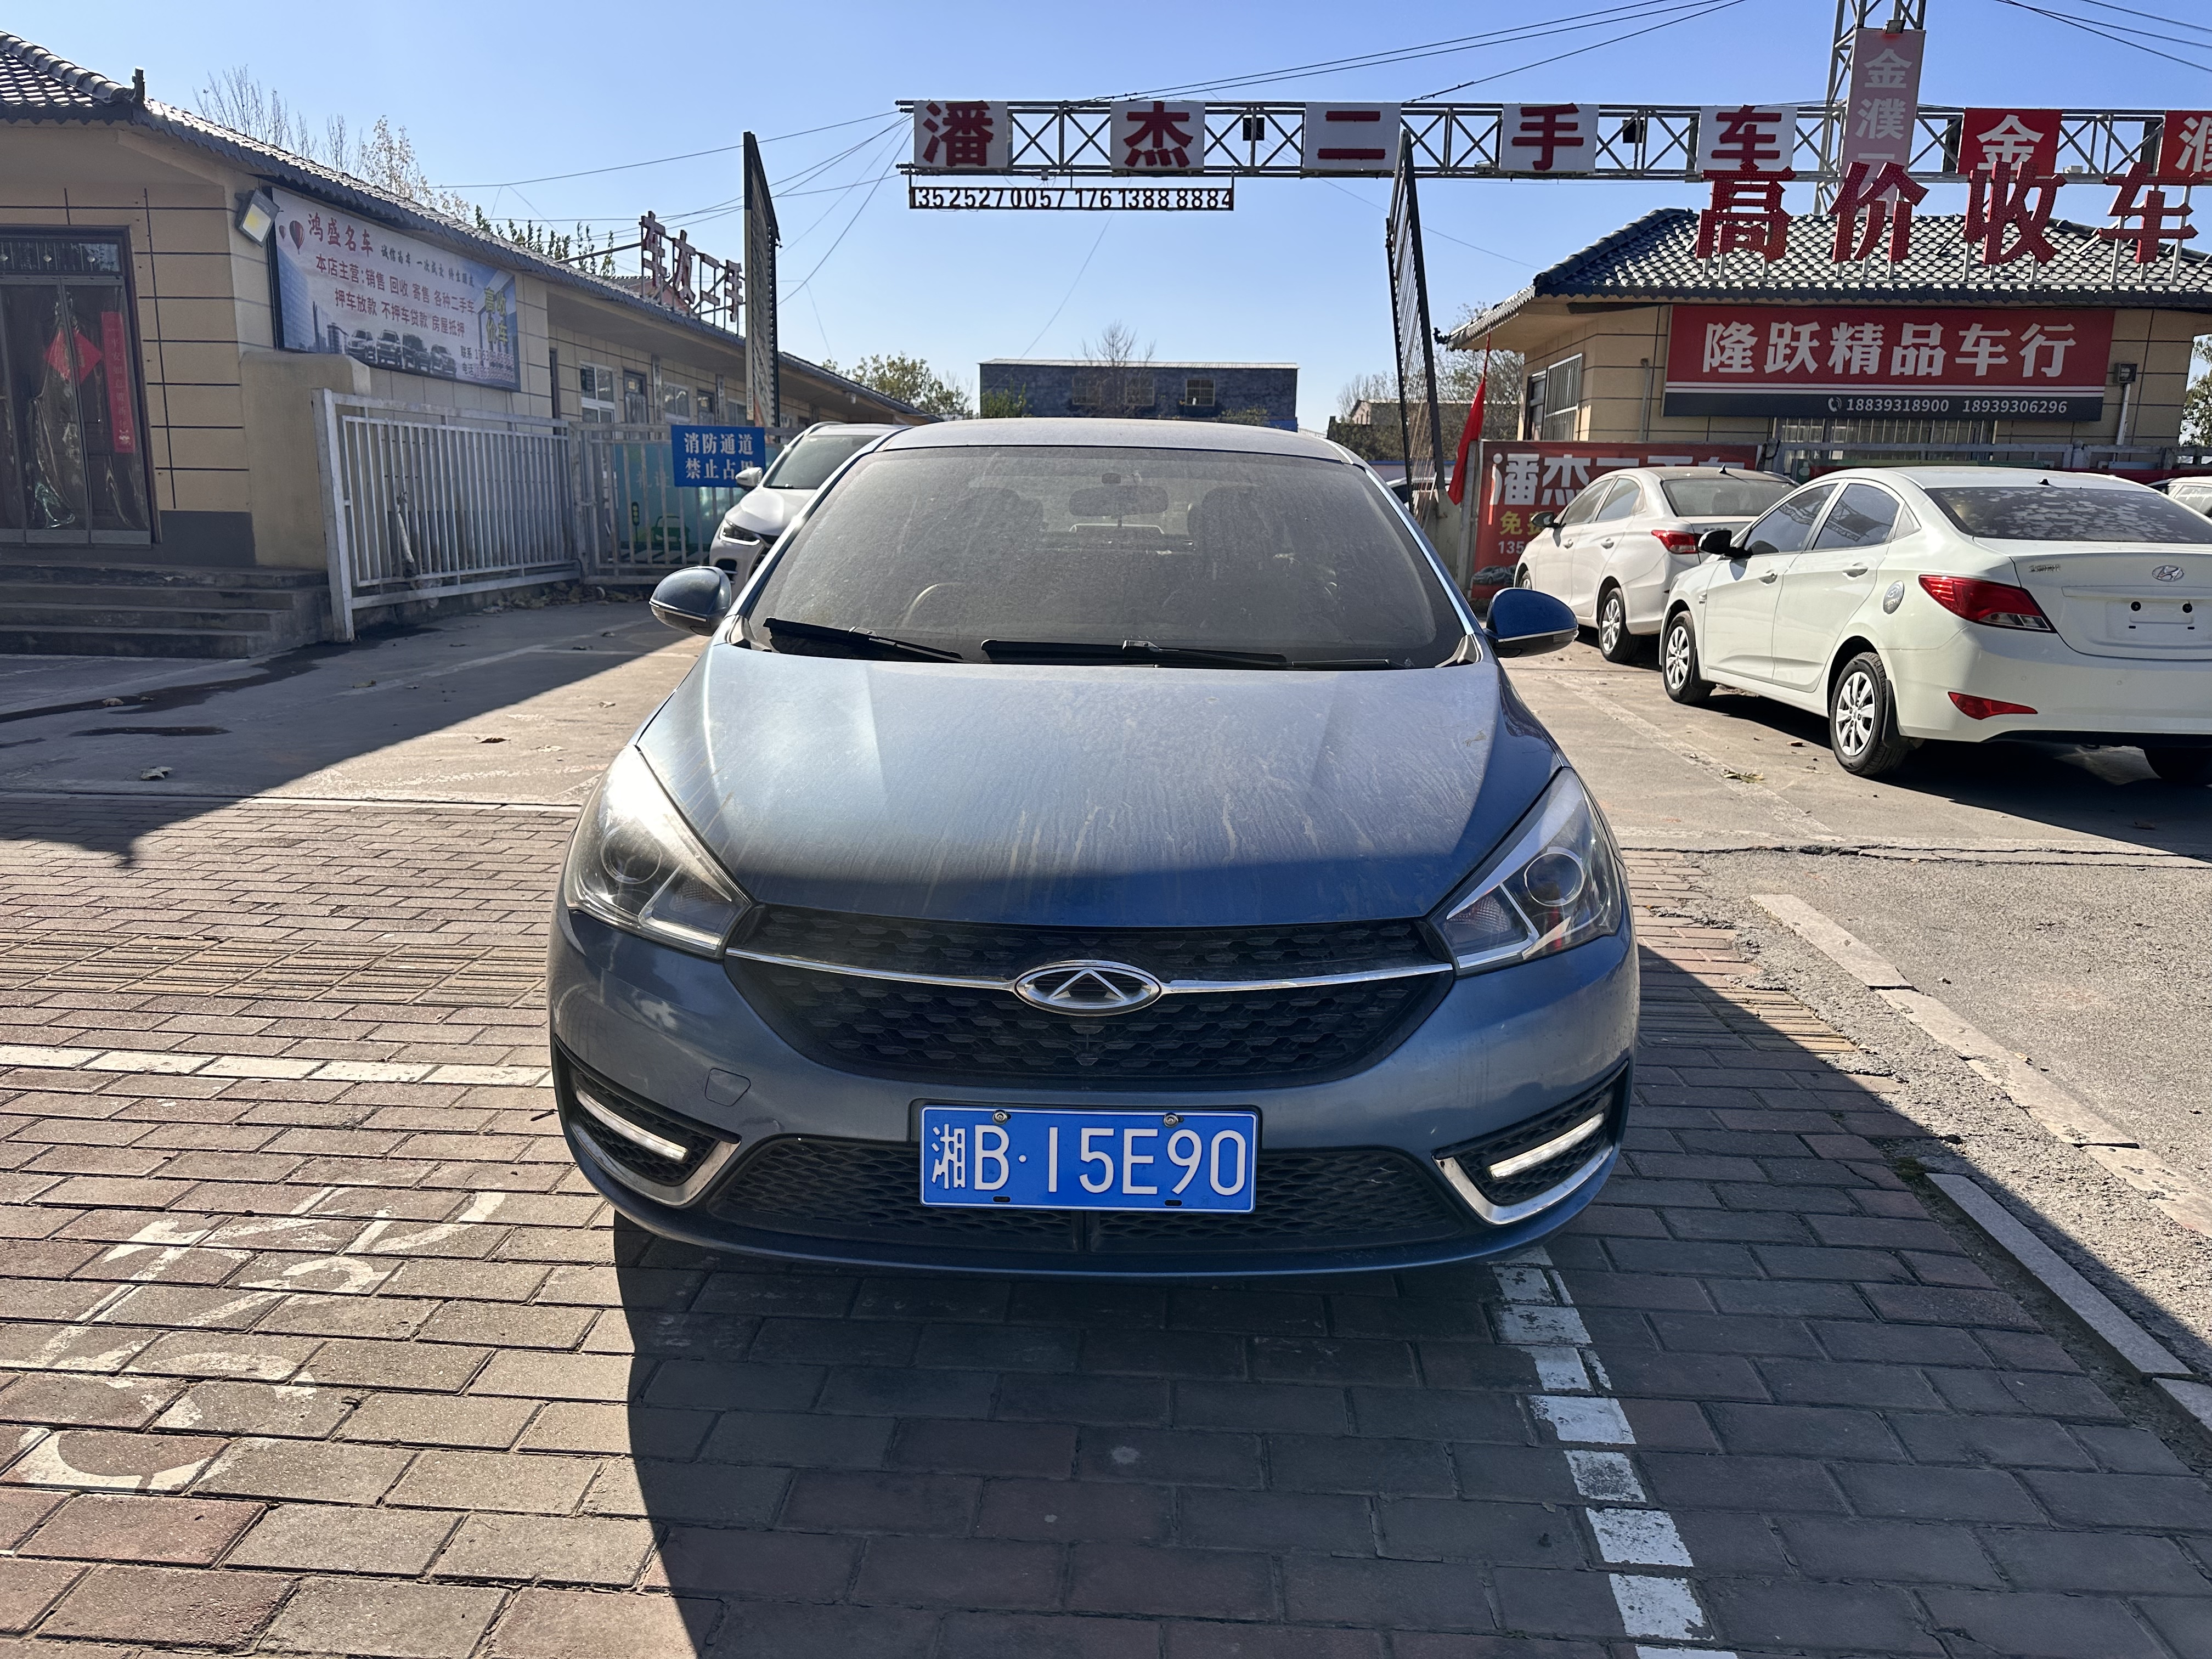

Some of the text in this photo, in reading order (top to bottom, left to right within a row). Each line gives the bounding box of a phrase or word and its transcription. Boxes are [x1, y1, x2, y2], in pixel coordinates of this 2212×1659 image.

[922, 100, 1782, 171] 潘杰二手车
[308, 212, 373, 257] 鸿盛名车
[1695, 161, 2204, 265] 高价收车
[335, 288, 465, 338] 押车放款 不押车贷款 房屋抵押
[390, 276, 408, 297] 回收
[413, 283, 430, 303] 寄售
[434, 290, 476, 315] 各种二手车
[1702, 321, 2076, 379] 隆跃精品车行
[1847, 398, 2068, 414] 18839318900 18939306296
[684, 432, 754, 455] 消防通道
[931, 1123, 1246, 1196] 湘B·15E90
